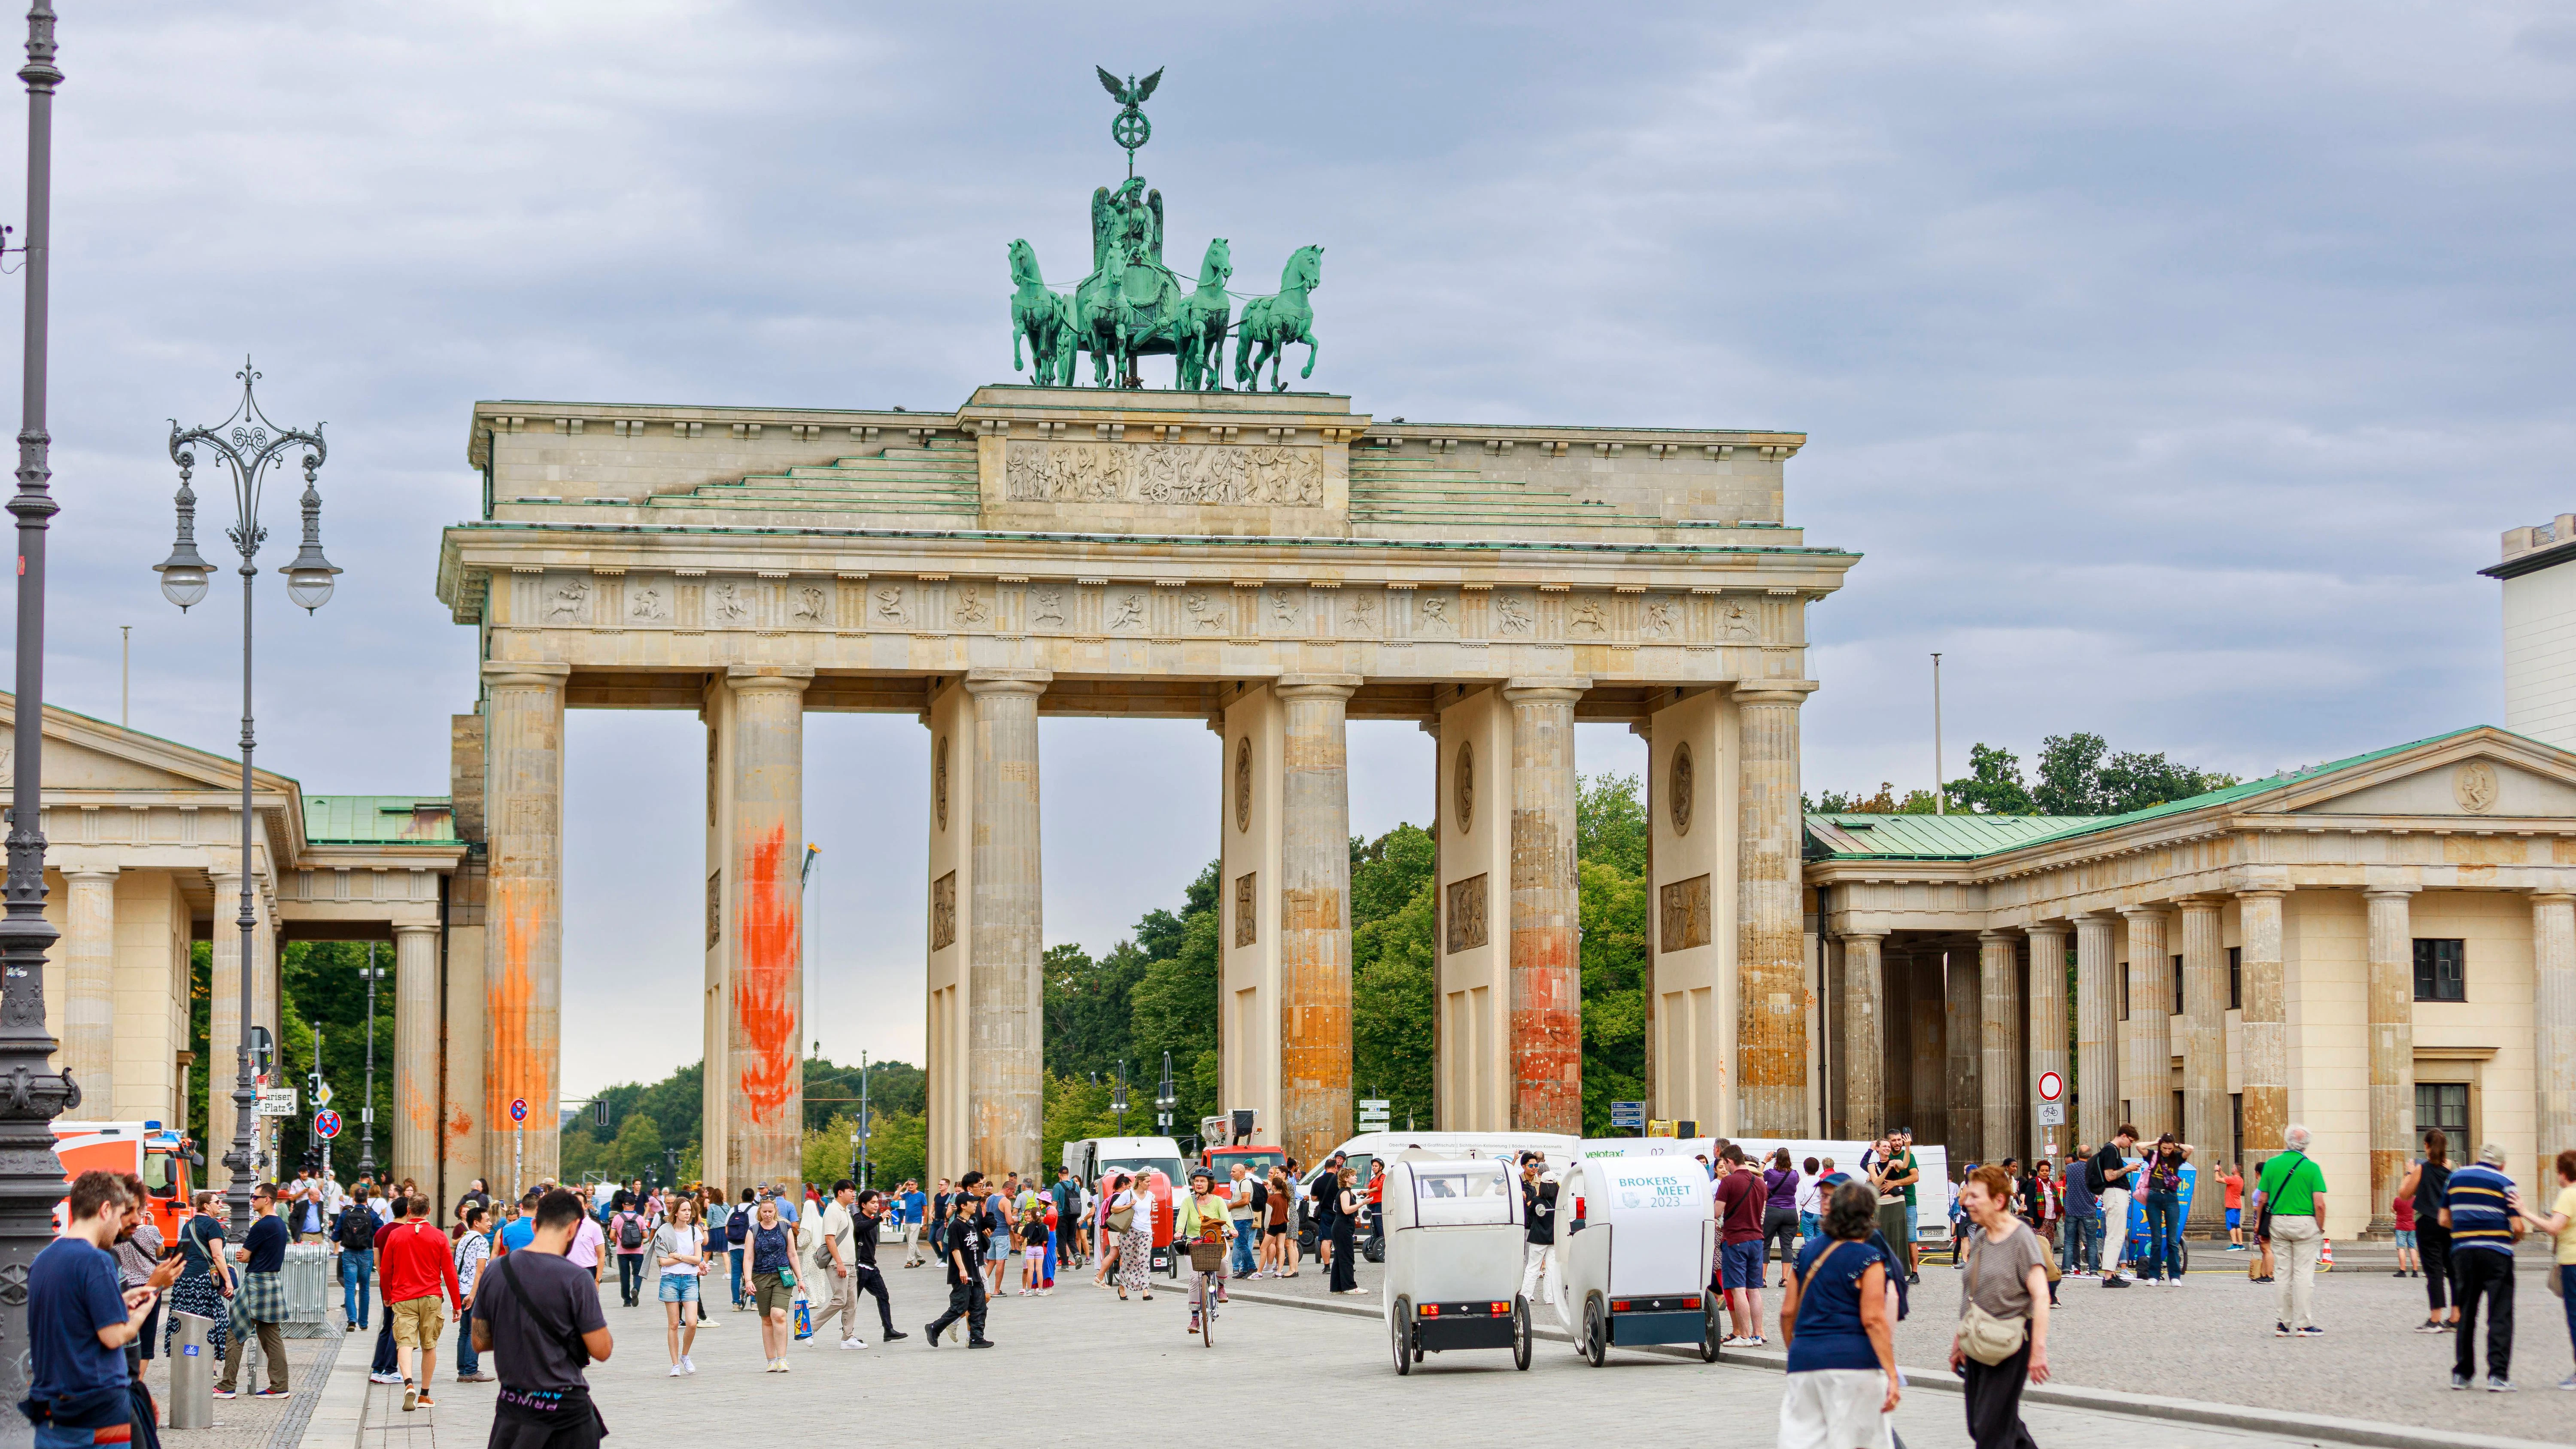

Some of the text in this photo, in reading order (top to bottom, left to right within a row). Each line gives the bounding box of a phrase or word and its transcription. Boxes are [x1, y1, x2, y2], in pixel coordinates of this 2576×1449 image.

[264, 1103, 286, 1112] Platz
[1585, 1150, 1625, 1158] velotaxi
[1651, 1148, 1664, 1156] 02
[1619, 1176, 1677, 1187] BROKERS
[1656, 1185, 1691, 1196] MEET
[1650, 1197, 1680, 1208] 2023
[500, 1390, 558, 1411] PRINCE
